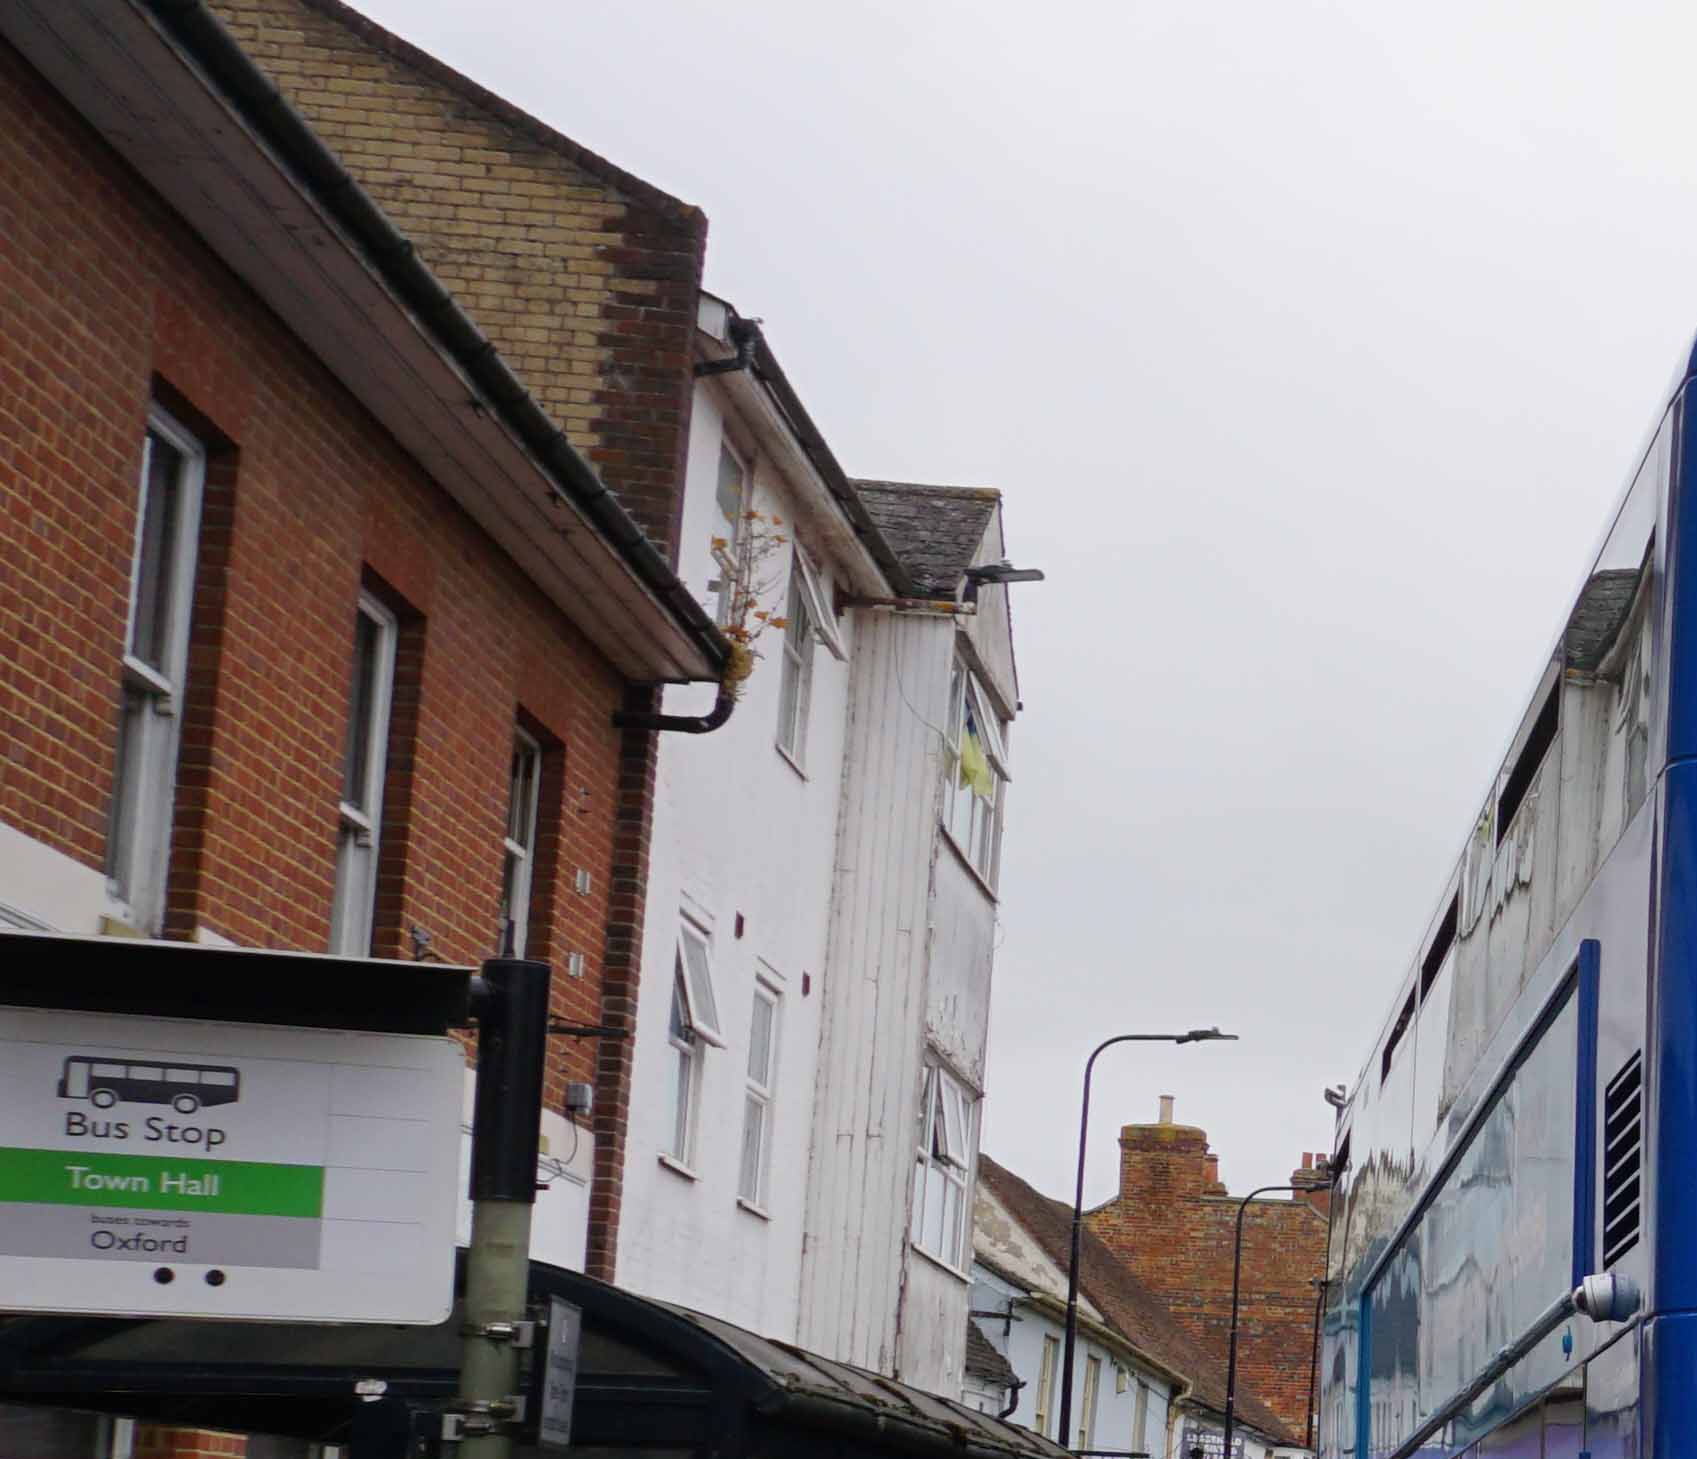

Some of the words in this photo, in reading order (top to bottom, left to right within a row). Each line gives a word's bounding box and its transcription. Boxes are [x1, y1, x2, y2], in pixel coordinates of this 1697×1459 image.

[65, 1112, 129, 1139] Bus
[144, 1116, 226, 1152] Stop
[64, 1165, 149, 1193] Town
[160, 1171, 219, 1196] Hall
[91, 1230, 188, 1254] Oxford
